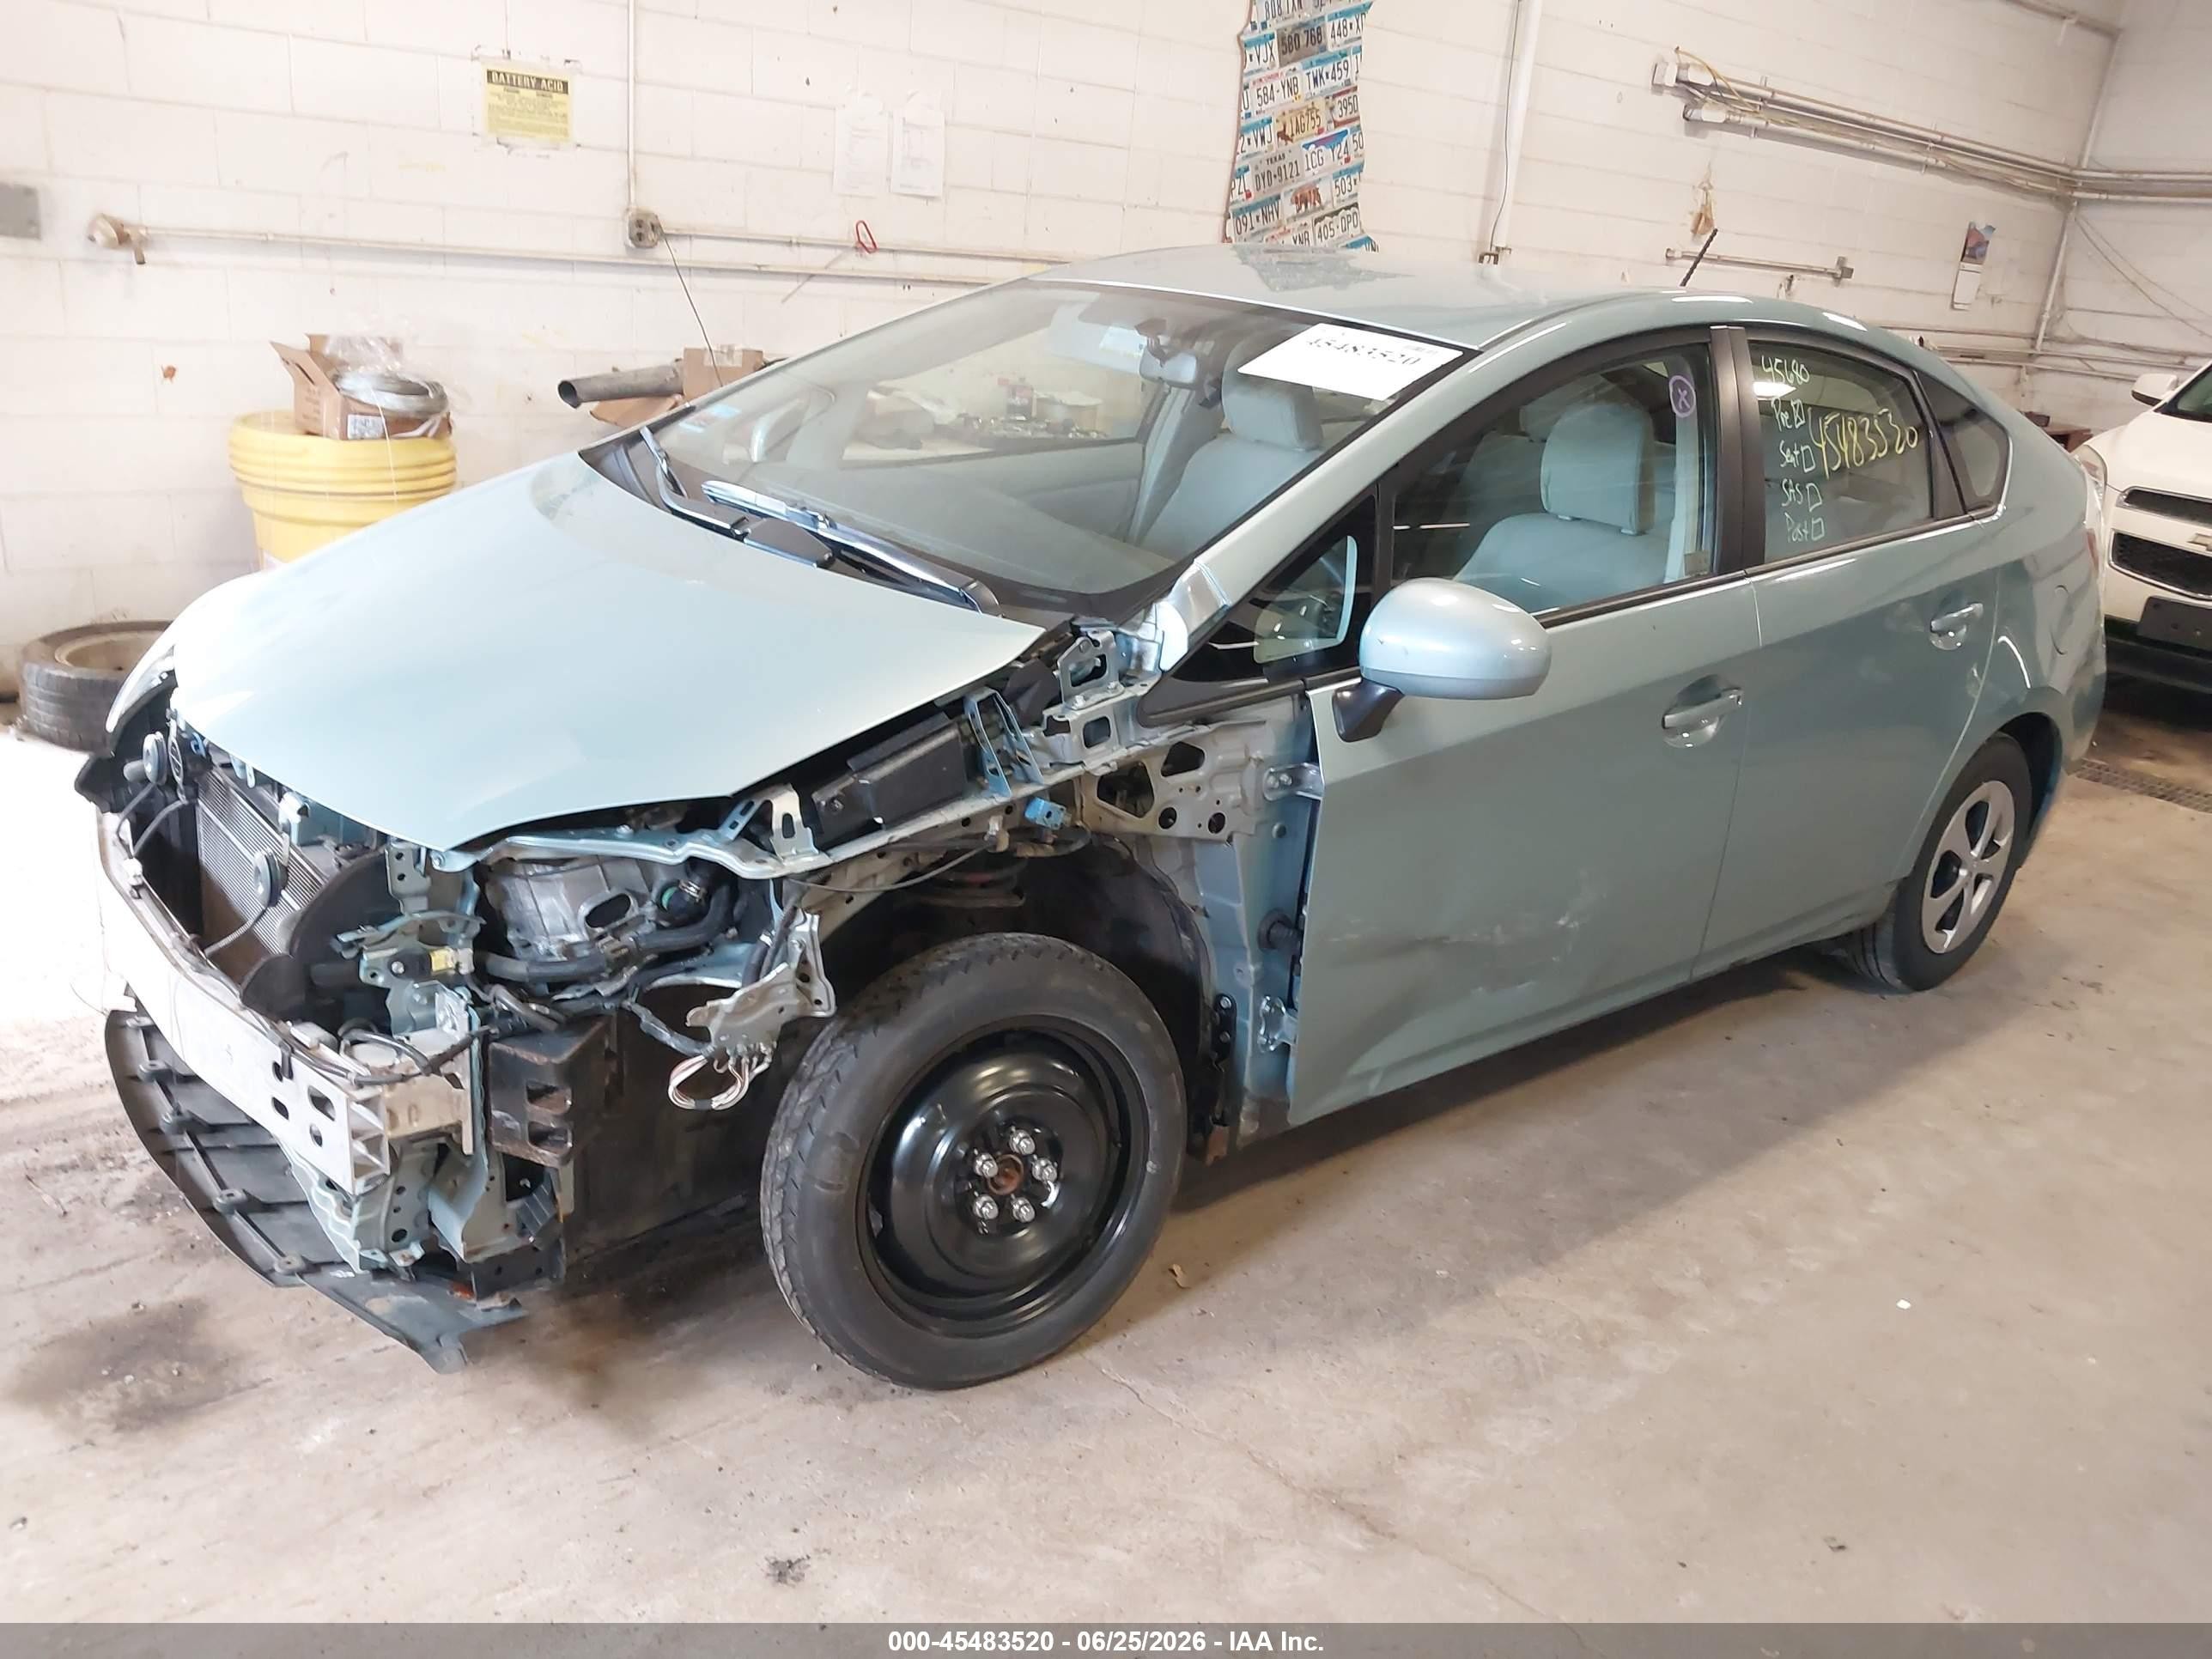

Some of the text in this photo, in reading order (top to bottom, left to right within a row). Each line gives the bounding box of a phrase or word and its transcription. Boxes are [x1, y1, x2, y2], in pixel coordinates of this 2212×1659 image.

[1304, 26, 1322, 47] 768
[1331, 20, 1347, 40] 448
[491, 70, 564, 93] BATTERY ACID
[1331, 60, 1349, 82] 459
[1267, 153, 1285, 166] TEXAS
[1277, 160, 1300, 184] 9121
[1334, 174, 1353, 198] 503
